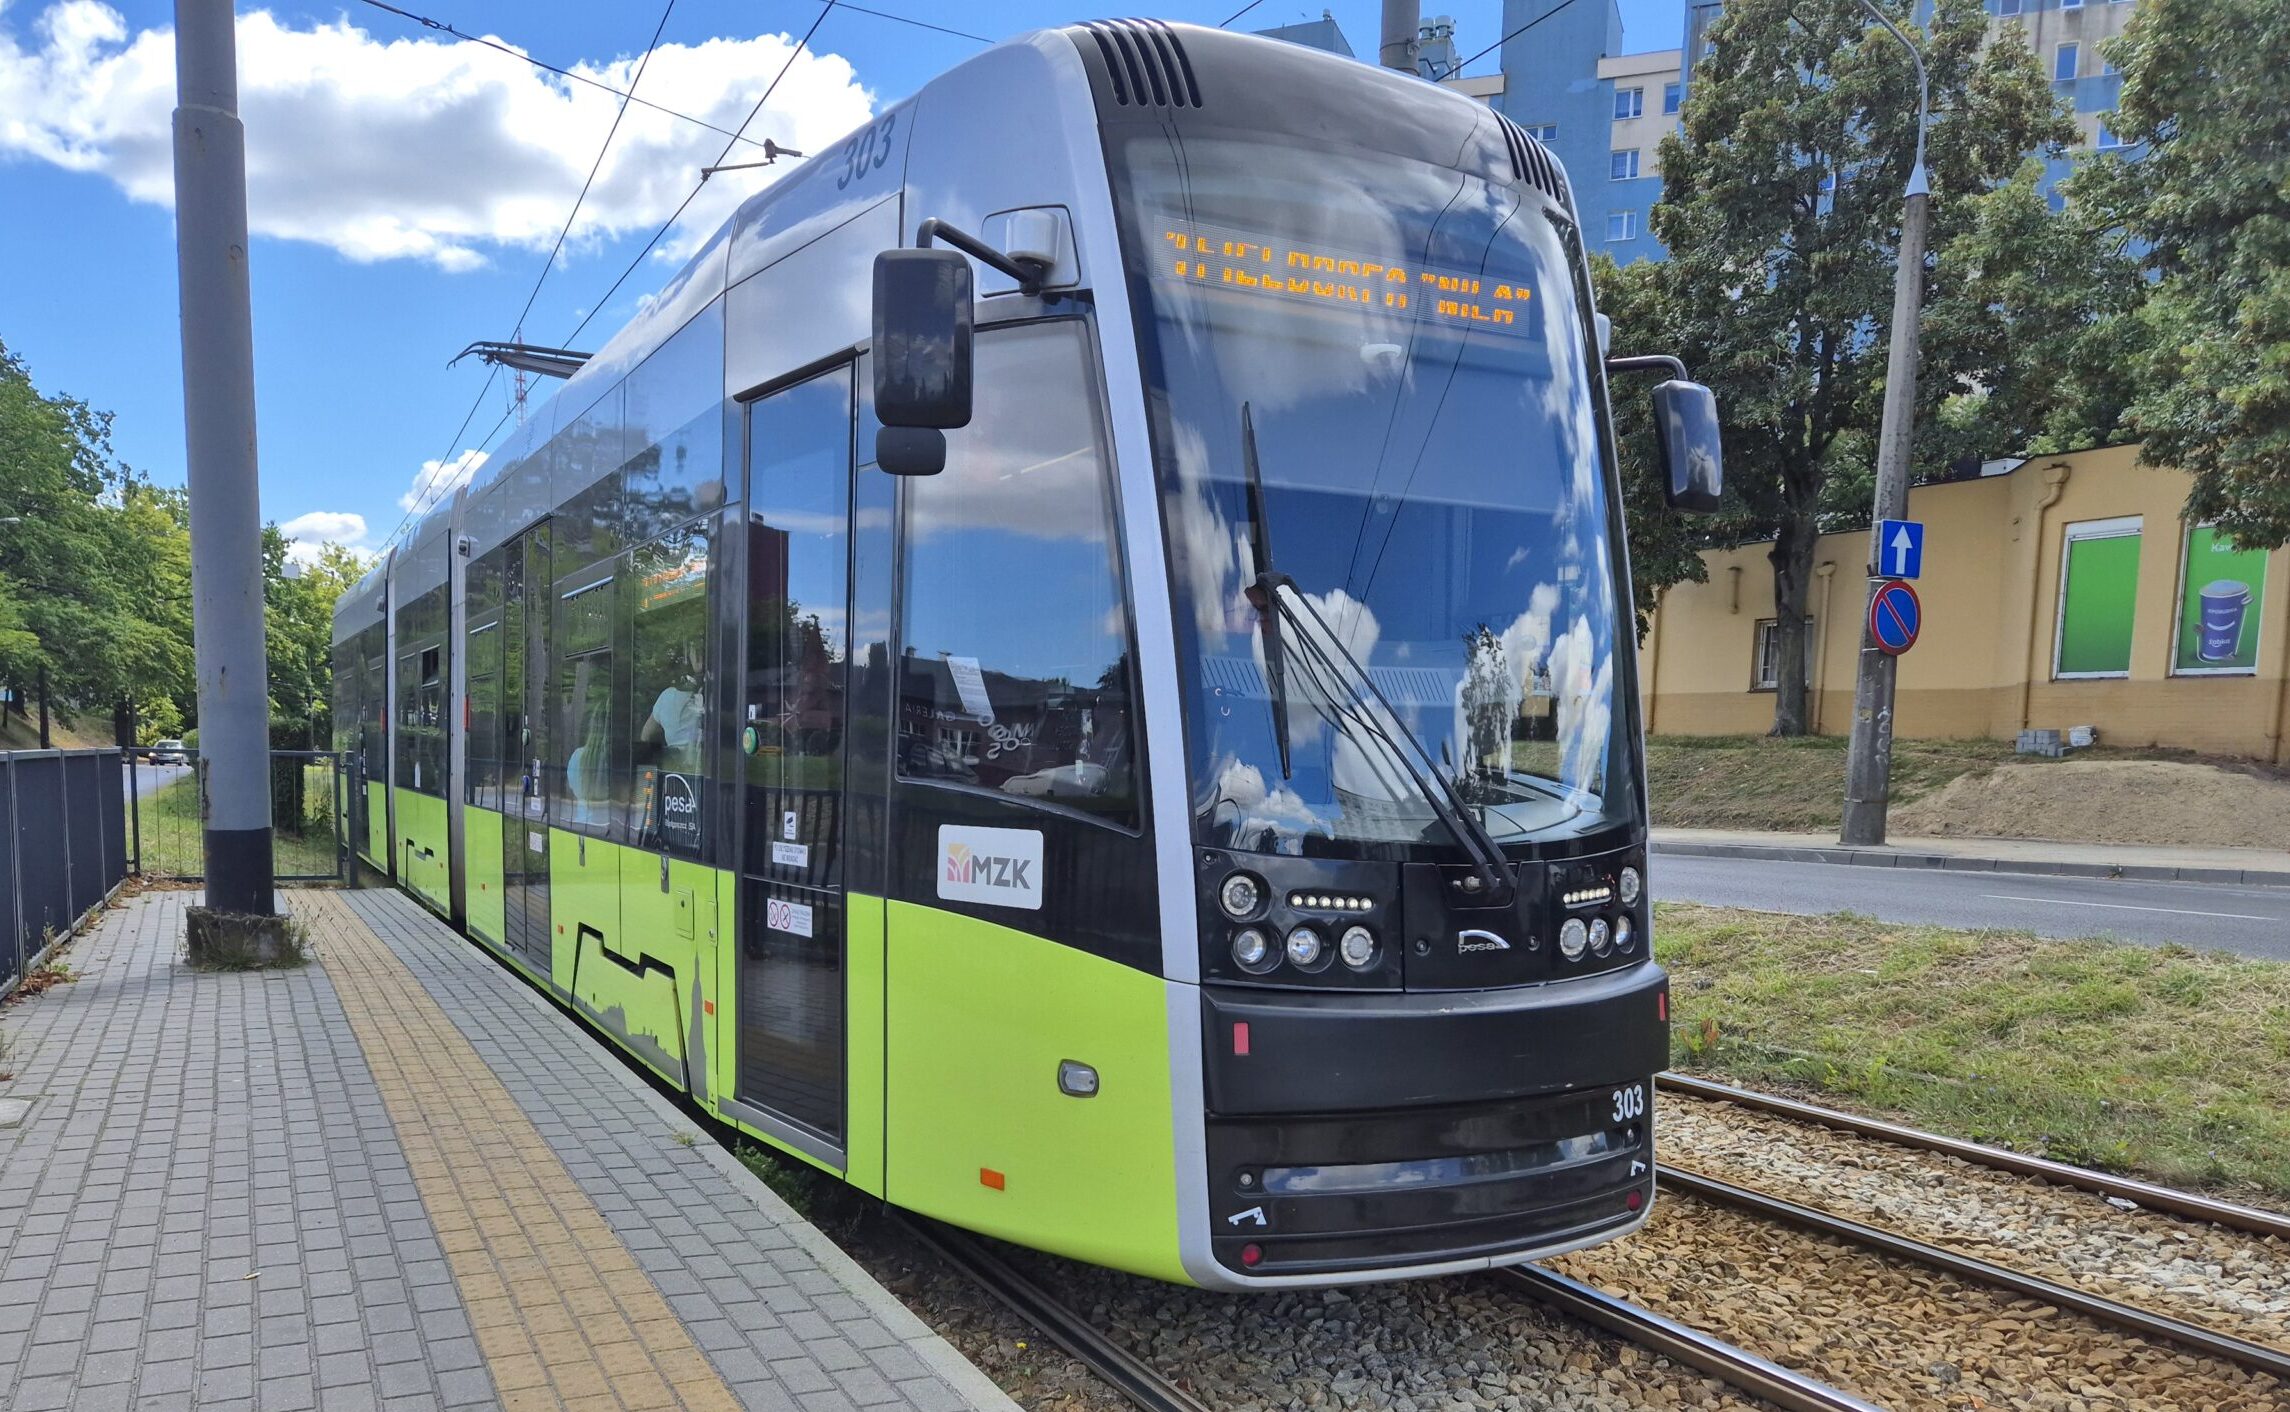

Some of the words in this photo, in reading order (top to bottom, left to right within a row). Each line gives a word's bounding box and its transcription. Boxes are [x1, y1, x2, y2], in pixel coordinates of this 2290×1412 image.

[837, 114, 896, 191] 303
[664, 795, 693, 816] pesa
[971, 855, 1031, 890] MZK
[1612, 1085, 1645, 1123] 303
